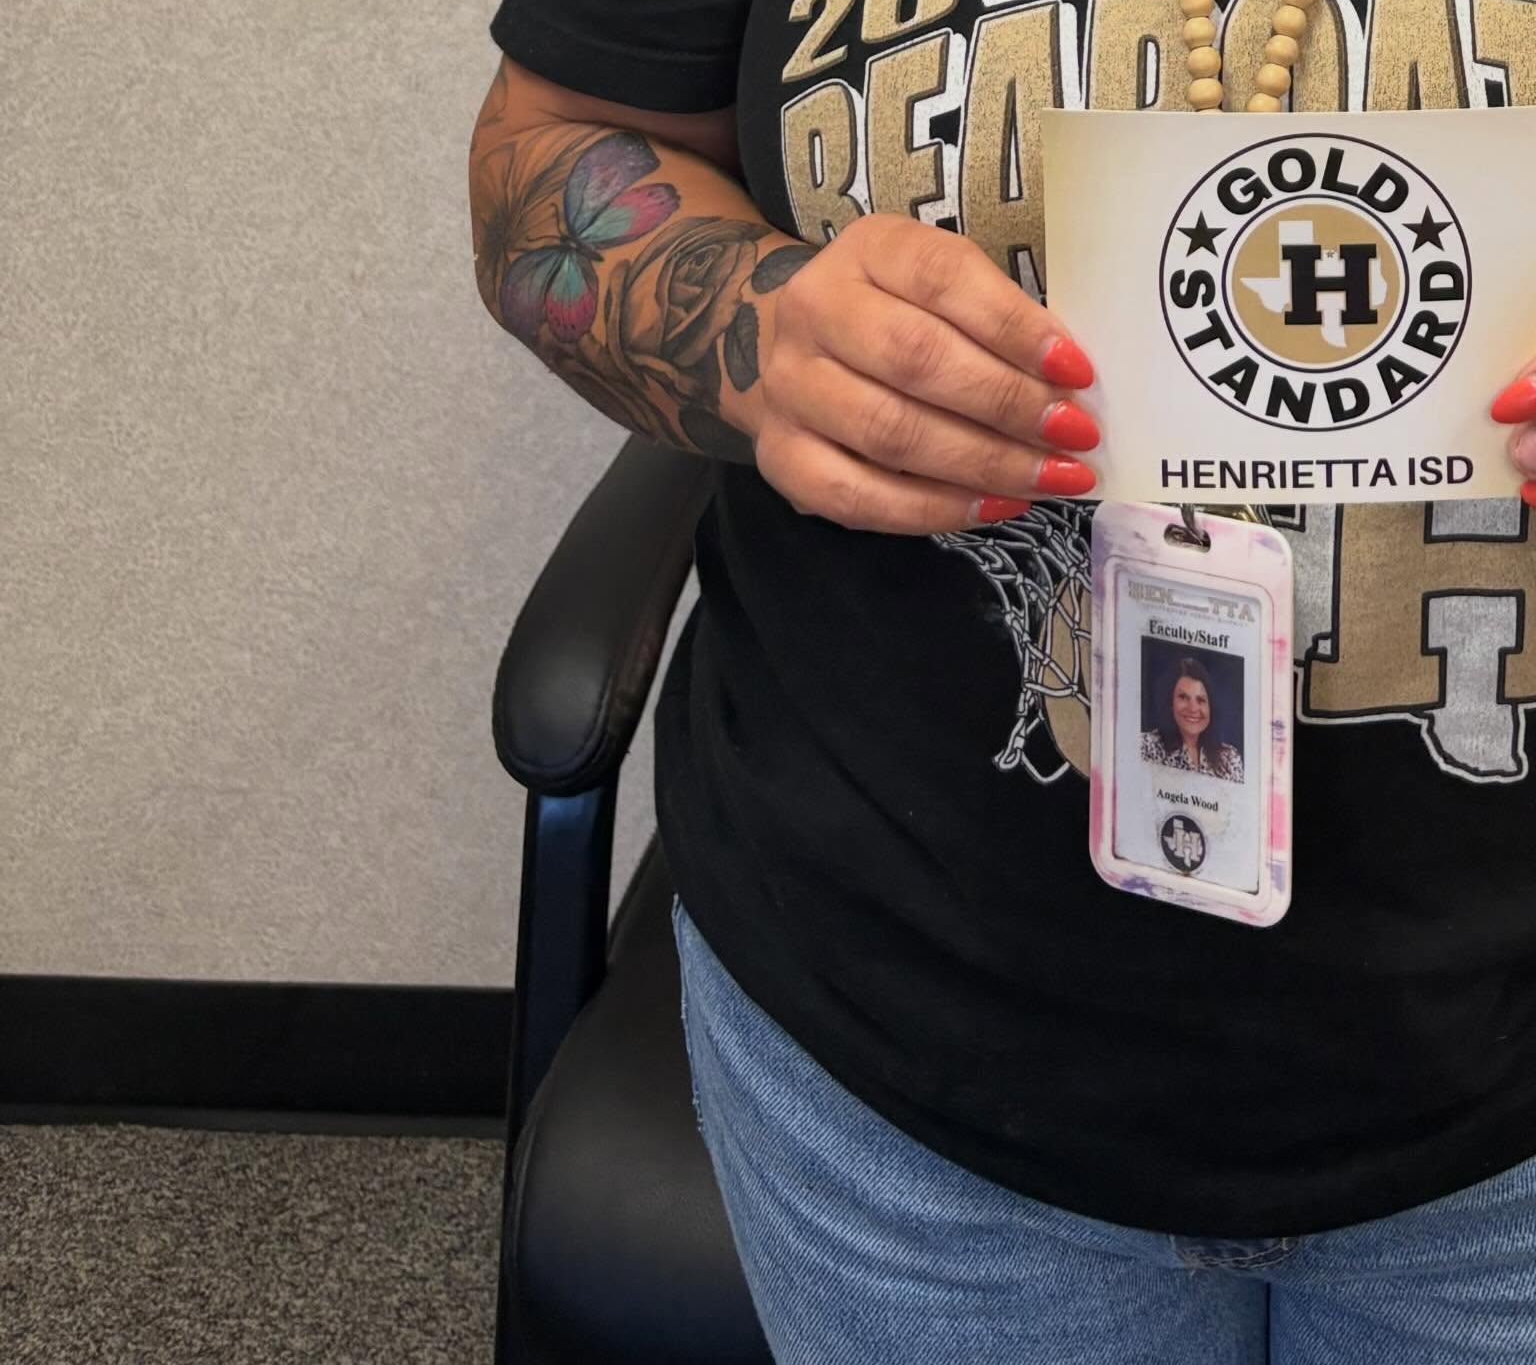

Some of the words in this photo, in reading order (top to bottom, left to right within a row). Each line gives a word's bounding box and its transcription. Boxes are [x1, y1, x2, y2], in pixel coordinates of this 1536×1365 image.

[1216, 147, 1410, 215] GOLD
[1281, 243, 1379, 327] H
[1169, 259, 1465, 424] STANDARD
[1161, 457, 1398, 490] HENRIETTA
[1408, 455, 1475, 487] ISD
[1148, 617, 1231, 649] Faculty/Staff
[1156, 788, 1189, 805] Angela
[1191, 795, 1219, 812] Wood
